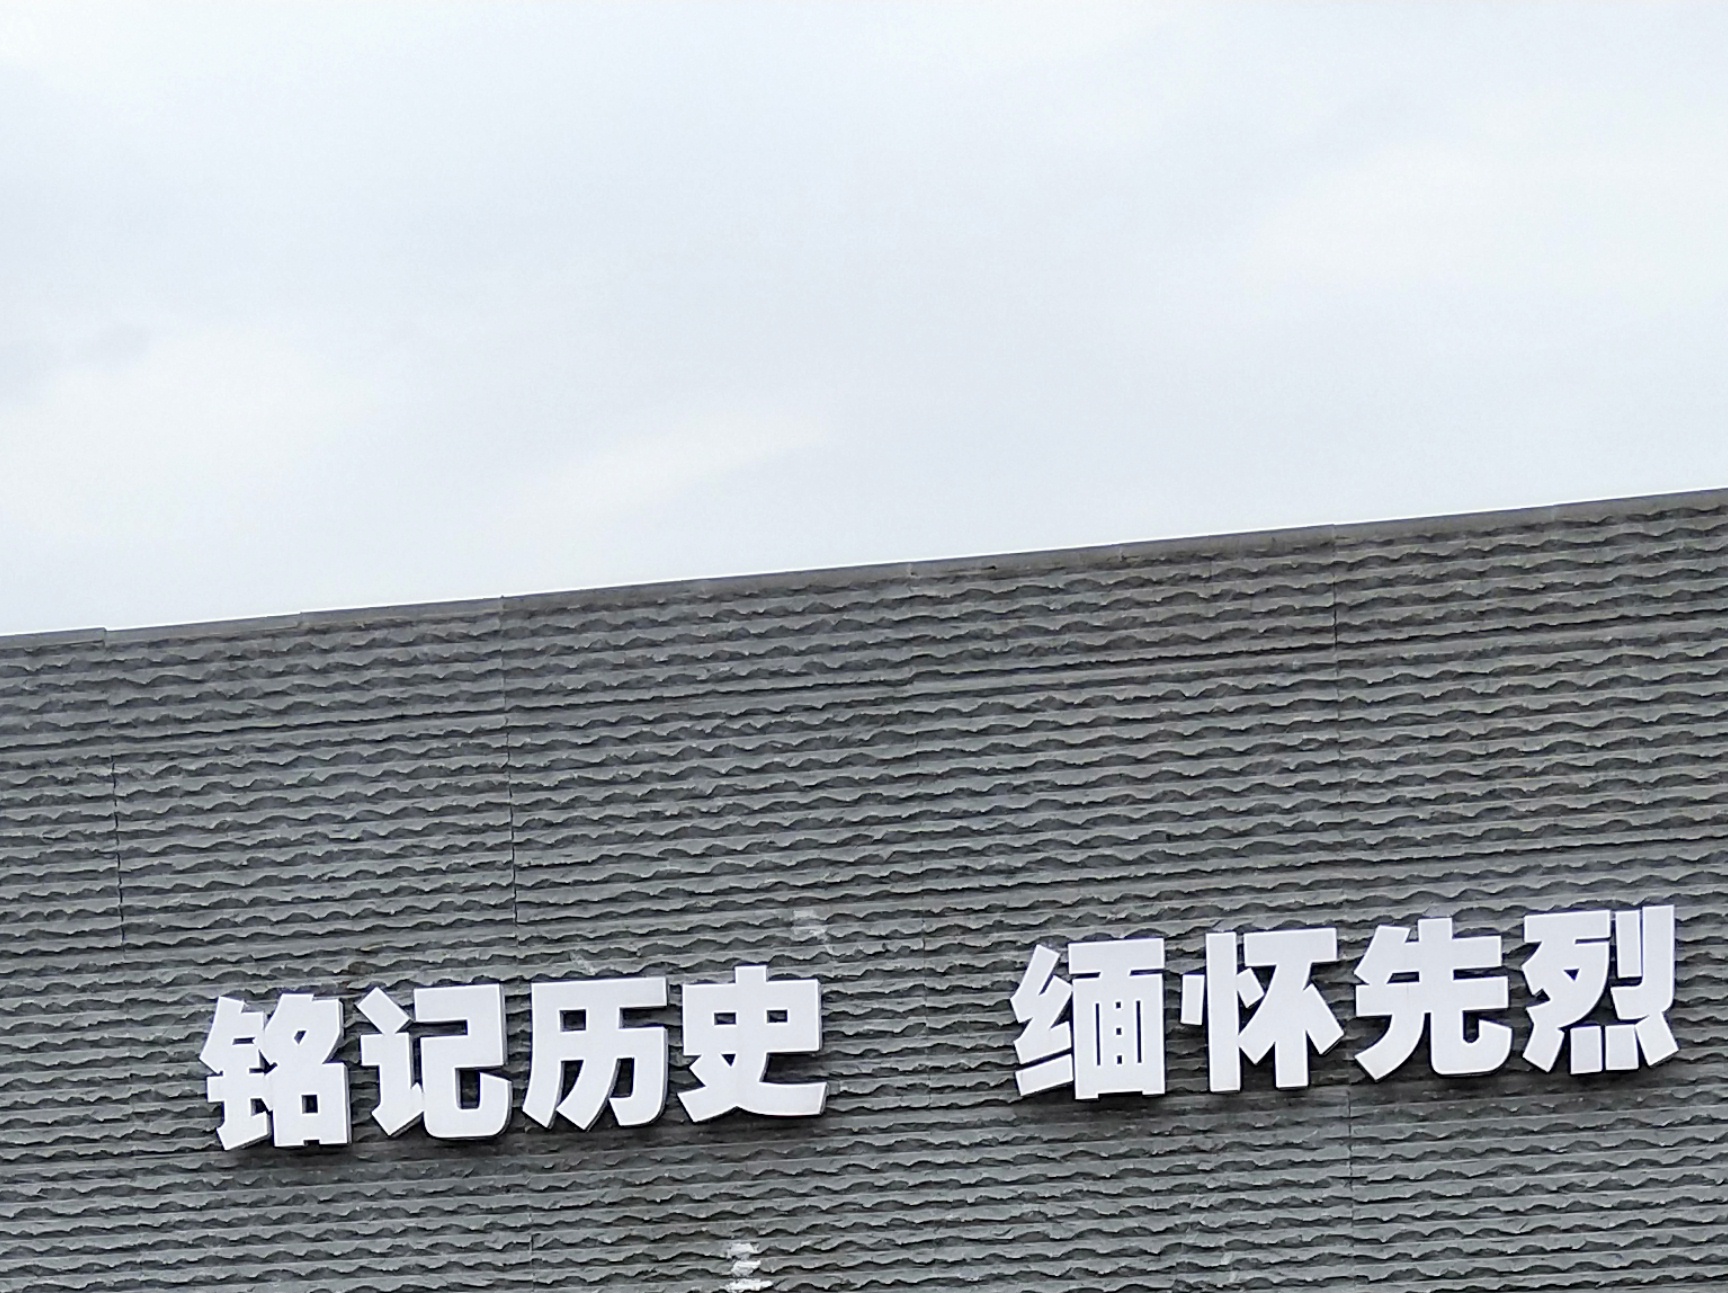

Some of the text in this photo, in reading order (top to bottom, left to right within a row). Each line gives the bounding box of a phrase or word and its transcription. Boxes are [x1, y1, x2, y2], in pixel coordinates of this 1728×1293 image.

[199, 964, 828, 1151] 铭记历史
[1010, 904, 1680, 1100] 缅怀先烈
